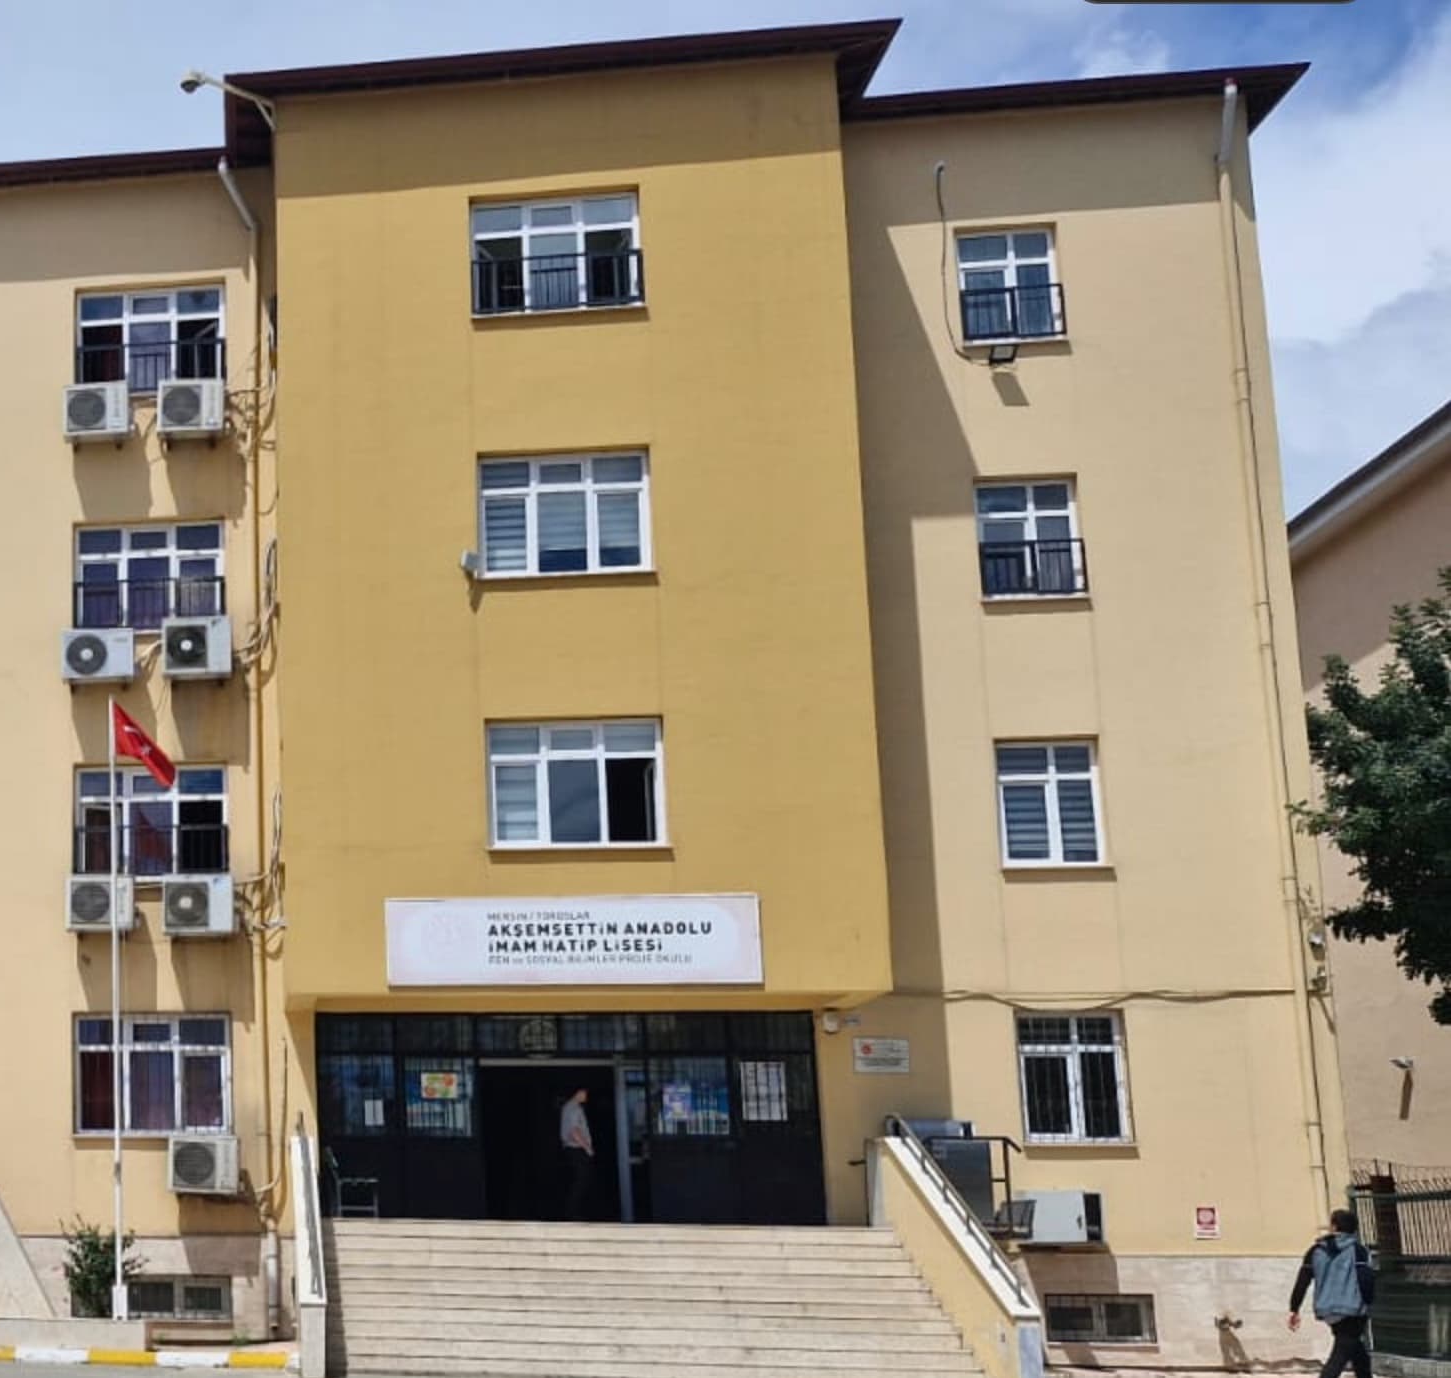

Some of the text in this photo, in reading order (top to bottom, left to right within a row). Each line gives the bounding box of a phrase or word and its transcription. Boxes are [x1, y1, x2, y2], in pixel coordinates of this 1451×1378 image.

[488, 921, 712, 938] AKŞEMSETTİN ANADOLU
[488, 938, 663, 953] İMAM HATİP LİSESİ
